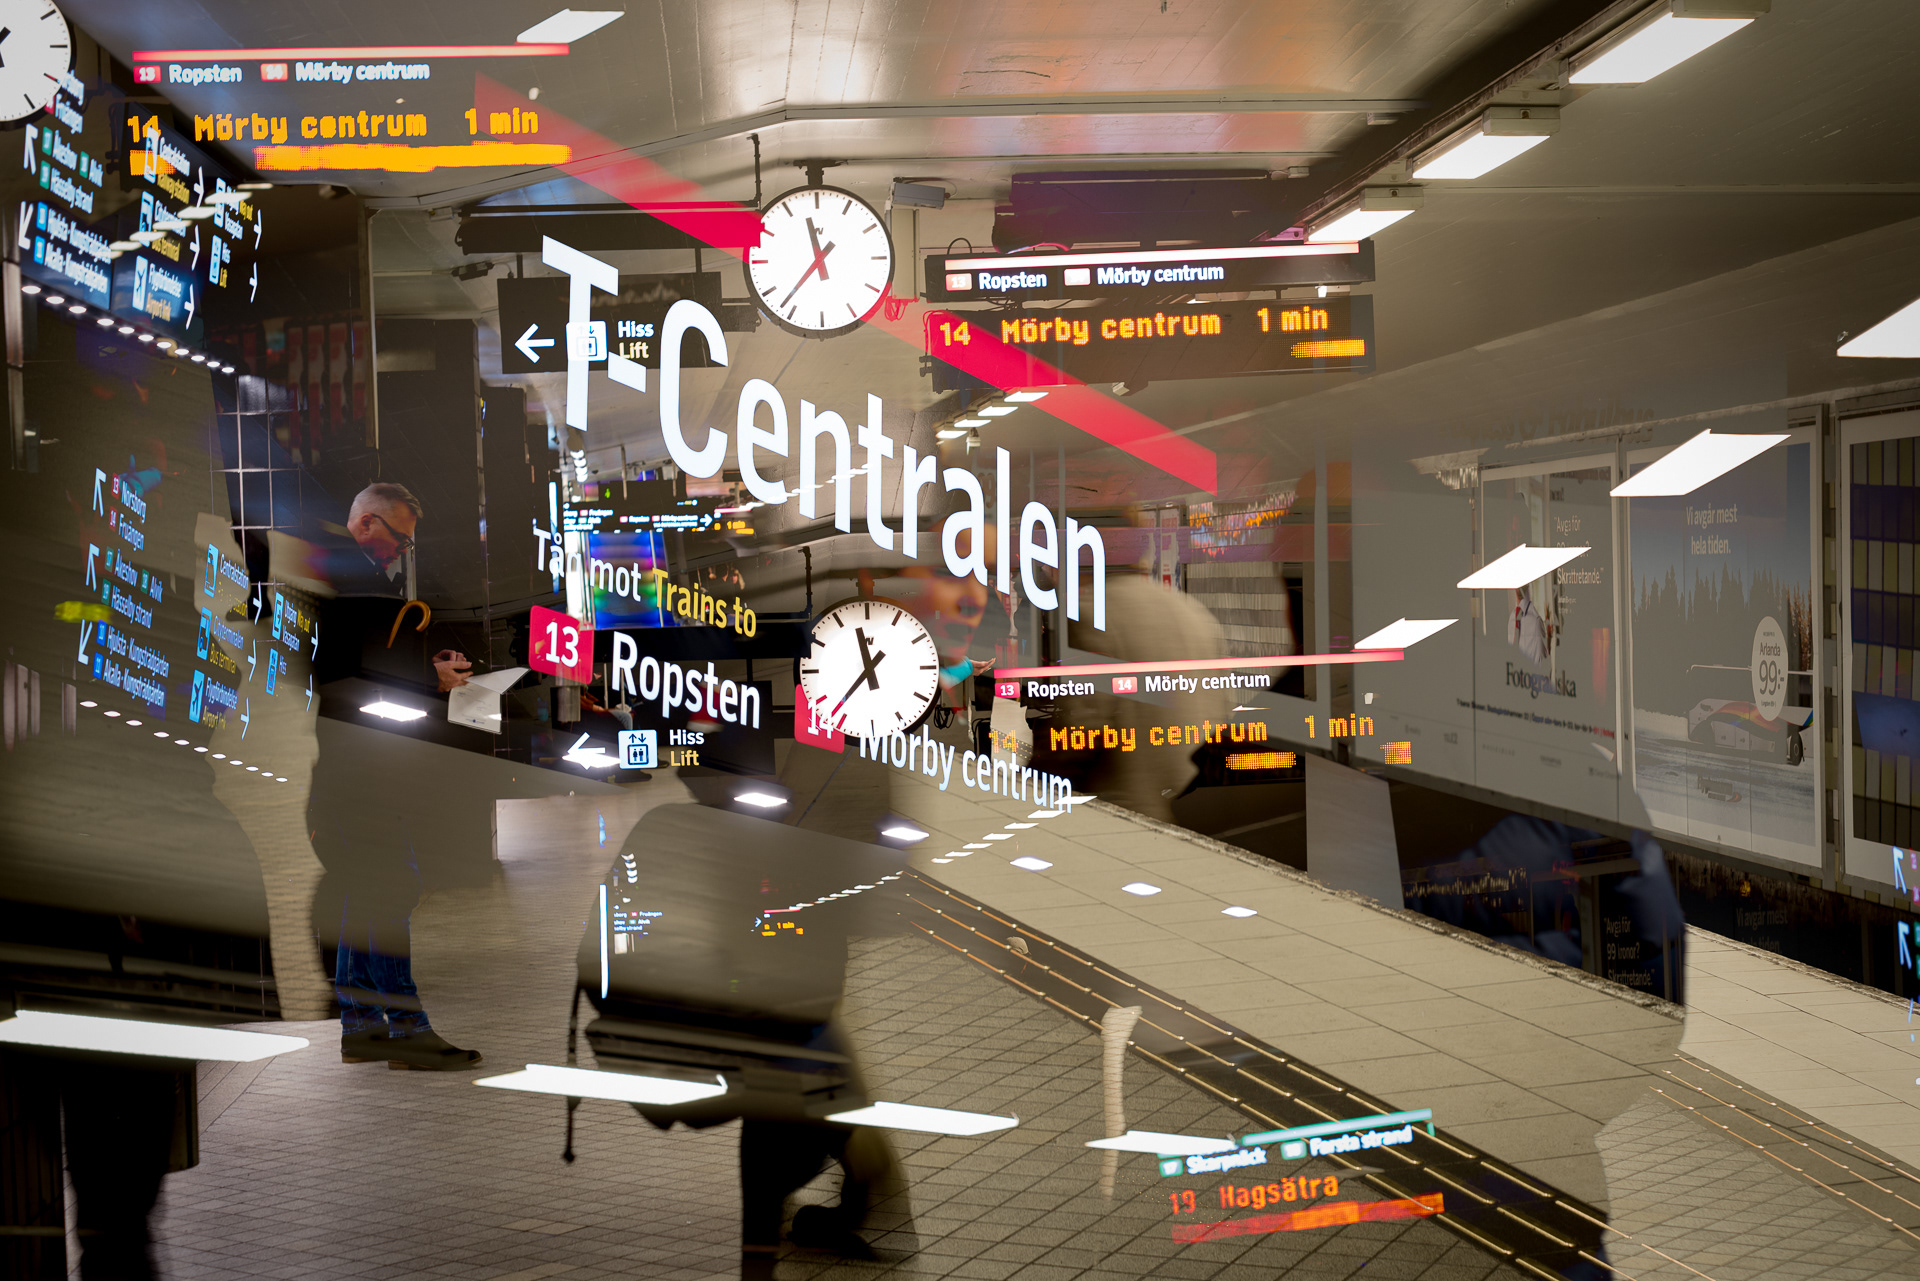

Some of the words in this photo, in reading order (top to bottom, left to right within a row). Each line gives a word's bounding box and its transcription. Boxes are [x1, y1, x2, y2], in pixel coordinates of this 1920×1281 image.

[168, 63, 243, 86] Ropsten
[295, 62, 351, 84] Mörby
[353, 62, 430, 81] centrum
[194, 112, 289, 144] Mörby
[301, 108, 427, 139] centrum
[464, 108, 479, 136] 1
[489, 107, 539, 135] min
[978, 271, 1048, 293] Ropsten
[1096, 267, 1151, 287] Mörby
[1153, 264, 1225, 283] centrum
[617, 320, 655, 338] Hiss
[939, 321, 972, 347] 14
[1001, 316, 1090, 346] Mörby
[1100, 312, 1222, 341] centrum
[1257, 307, 1270, 332] 1
[1280, 305, 1329, 332] min
[618, 341, 650, 361] Lift
[541, 235, 1106, 632] T-Centralen
[121, 480, 147, 524] Norsborg
[1686, 506, 1695, 526] Vi
[1694, 502, 1716, 530] avgår
[1716, 503, 1738, 524] mest
[1691, 535, 1707, 555] hela
[1707, 535, 1732, 555] tiden.
[219, 553, 249, 591] Centralstation
[589, 556, 642, 602] mot
[652, 567, 728, 630] Trains
[733, 596, 758, 638] to
[134, 601, 153, 629] strand
[213, 615, 244, 650] Cityterminalen
[544, 620, 580, 669] 13
[106, 624, 127, 657] Hjulsta
[128, 636, 170, 679] Kungsträdgården
[209, 643, 219, 664] Bus
[218, 652, 237, 674] terminal
[1759, 642, 1781, 657] Arlanda
[103, 658, 121, 688] Akalla
[279, 654, 287, 676] Hiss
[1759, 659, 1785, 695] 99:-
[611, 630, 761, 730] Ropsten
[999, 684, 1016, 698] 13
[1027, 681, 1096, 700] Ropsten
[1116, 678, 1133, 693] 14
[1144, 674, 1199, 695] Mörby
[1201, 672, 1272, 691] centrum
[668, 728, 706, 746] Hiss
[988, 728, 1019, 754] 14
[1049, 725, 1137, 752] Mörby
[1148, 719, 1268, 746] centrum
[1303, 715, 1316, 739] 1
[1328, 713, 1375, 738] min
[669, 750, 700, 767] Lift
[858, 723, 956, 792] Mörby
[961, 750, 1073, 814] centrum
[1606, 943, 1617, 961] 99
[1169, 1190, 1197, 1215] 19
[1219, 1174, 1340, 1211] Hagsätra
